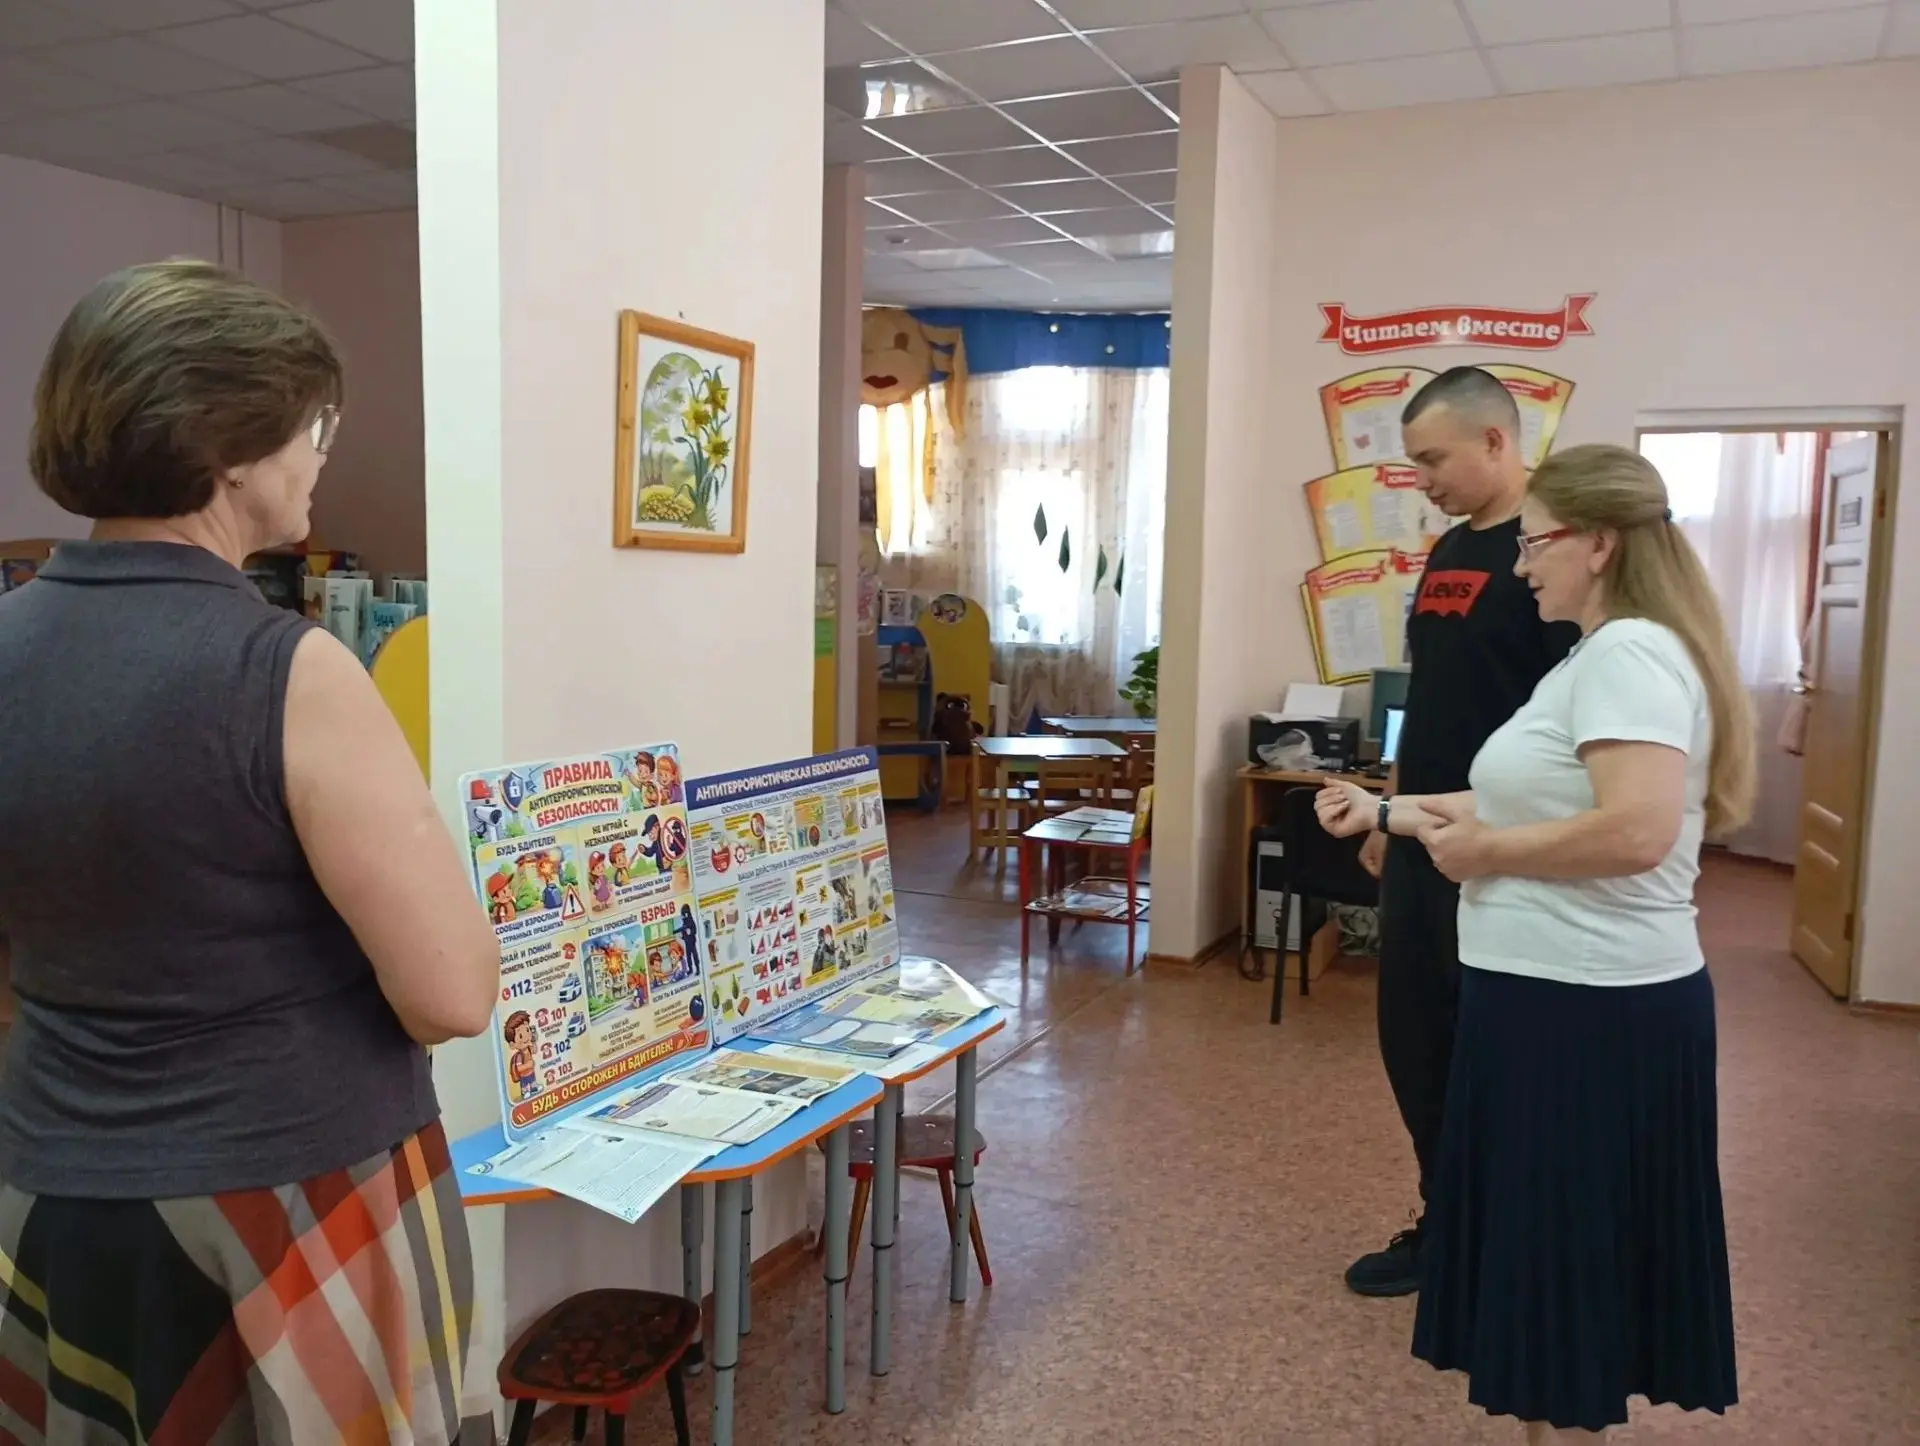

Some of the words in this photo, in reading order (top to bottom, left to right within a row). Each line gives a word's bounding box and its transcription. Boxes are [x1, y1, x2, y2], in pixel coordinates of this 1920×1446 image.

[1343, 319, 1451, 345] Читаем
[543, 760, 613, 790] ПРАВИЛА
[695, 766, 811, 802] АНТИТЕРРОРИСТИЧЕСКАЯ
[811, 754, 870, 777] БЕЗОПАСНОСТЬ
[528, 781, 624, 813] АНТИТЕРРОРИСТИЧЕСКОЙ
[536, 798, 619, 829] БЕЗОПАСНОСТИ
[584, 829, 638, 848] НЕЗНАКОМЦАМИ
[592, 824, 601, 835] НЕ
[602, 818, 622, 832] ИГРАЙ
[623, 819, 628, 828] С
[496, 845, 516, 857] БУДЬ
[518, 835, 556, 852] БДИТЕЛЕН
[495, 922, 523, 935] СООБЩИ
[525, 911, 560, 927] ВЗРОСЛЫМ
[588, 927, 603, 937] ЕСЛИ
[640, 901, 676, 924] ВЗРЫВ
[502, 930, 532, 944] СТРАННЫХ
[533, 920, 564, 935] ПРЕДМЕТАХ
[500, 950, 518, 965] ЗНАЙ
[521, 950, 526, 958] И
[528, 942, 552, 956] ПОМНИ
[511, 978, 532, 997] 112
[551, 1007, 567, 1021] 101
[554, 1038, 571, 1054] 102
[531, 1092, 559, 1114] БУДЬ
[561, 1064, 619, 1100] ОСТОРОЖЕН
[619, 1061, 626, 1073] И
[627, 1038, 674, 1069] БДИТЕЛЕН!
[558, 1062, 573, 1076] 103
